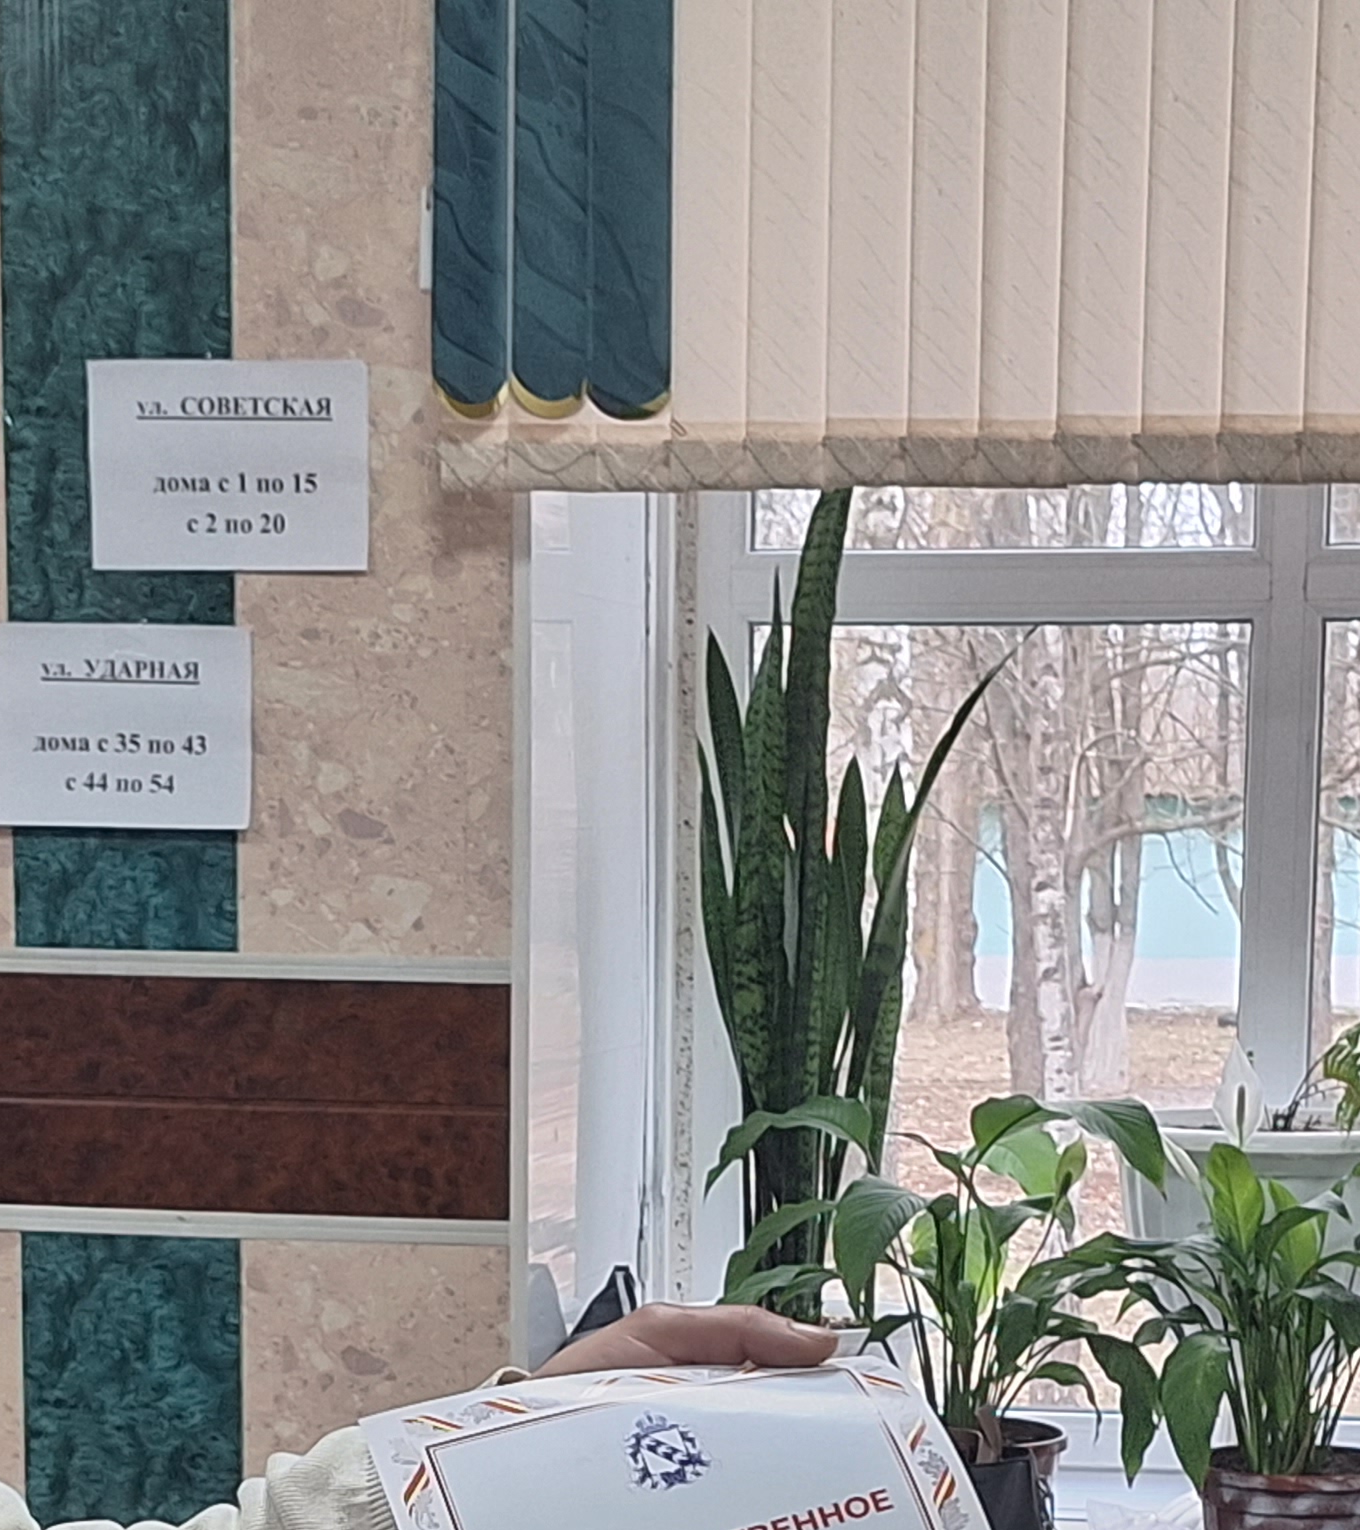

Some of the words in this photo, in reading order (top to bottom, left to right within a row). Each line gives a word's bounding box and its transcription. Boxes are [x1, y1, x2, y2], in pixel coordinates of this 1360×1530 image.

[136, 400, 168, 417] ул.
[180, 396, 333, 418] СОВЕТСКАЯ
[153, 476, 211, 494] дома
[218, 477, 229, 493] с
[237, 472, 246, 493] 1
[256, 477, 284, 493] по
[292, 472, 318, 494] 15
[187, 517, 199, 533] с
[205, 513, 217, 533] 2
[224, 518, 252, 534] по
[260, 513, 286, 534] 20
[41, 662, 72, 677] ул.
[84, 659, 200, 681] УДАРНАЯ
[33, 736, 90, 752] дома
[97, 737, 108, 752] с
[114, 733, 141, 753] 35
[148, 739, 175, 754] по
[182, 735, 207, 756] 43
[65, 776, 76, 791] с
[83, 772, 108, 792] 44
[115, 777, 142, 792] по
[149, 774, 175, 794] 54
